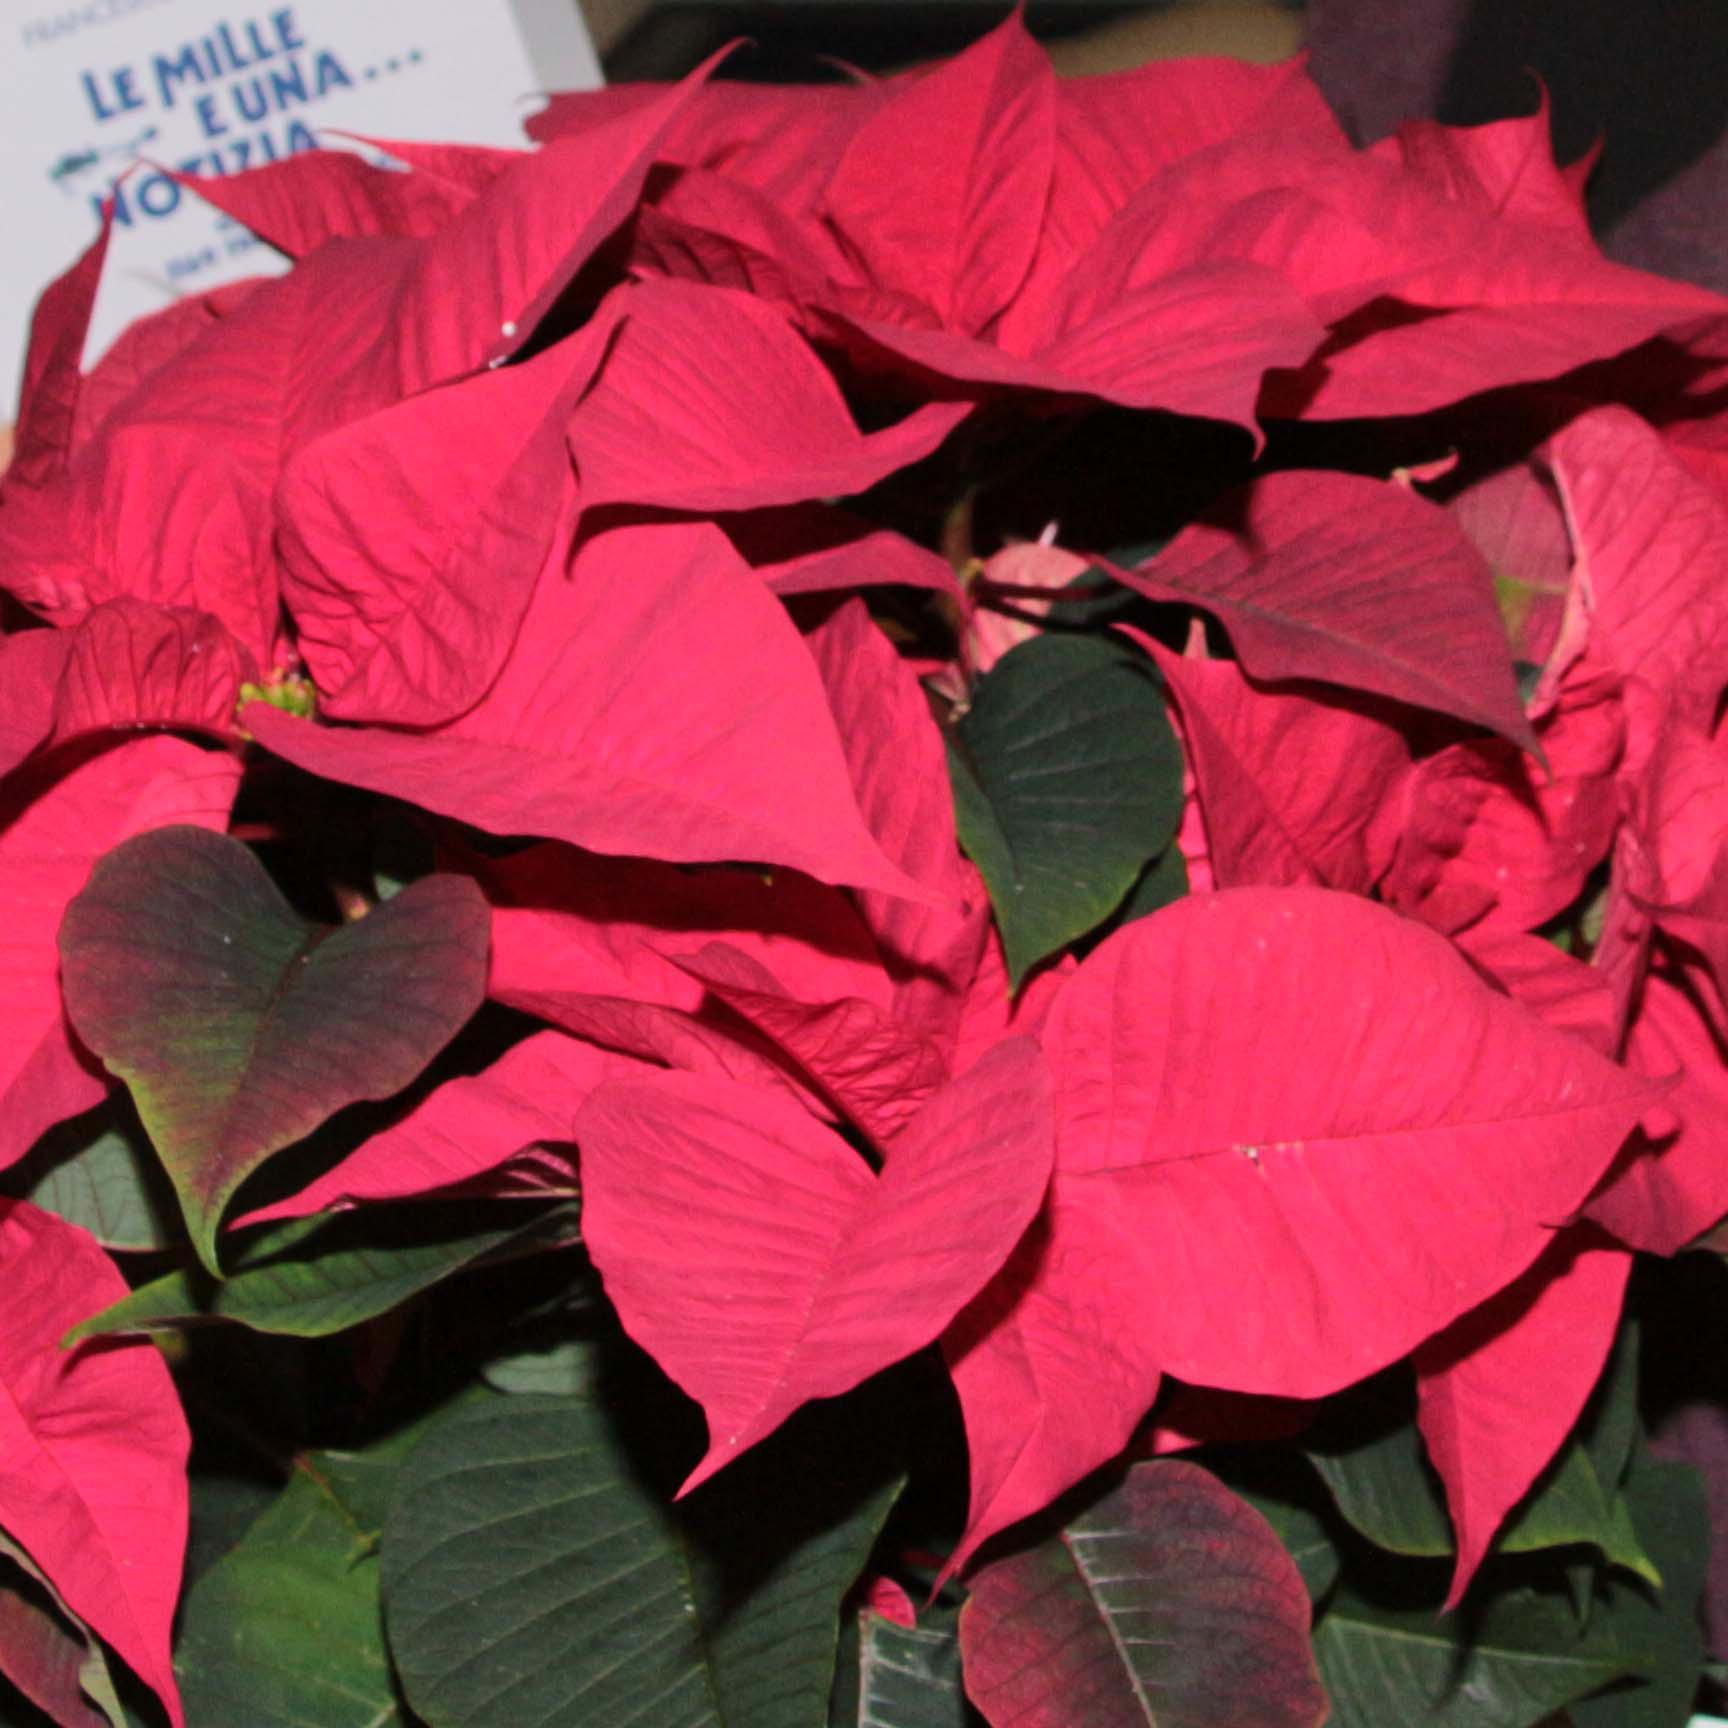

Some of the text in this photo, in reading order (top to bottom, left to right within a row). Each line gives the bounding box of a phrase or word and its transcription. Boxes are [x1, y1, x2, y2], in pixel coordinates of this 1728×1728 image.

[80, 5, 308, 124] LE MILLE
[194, 93, 229, 139] E
